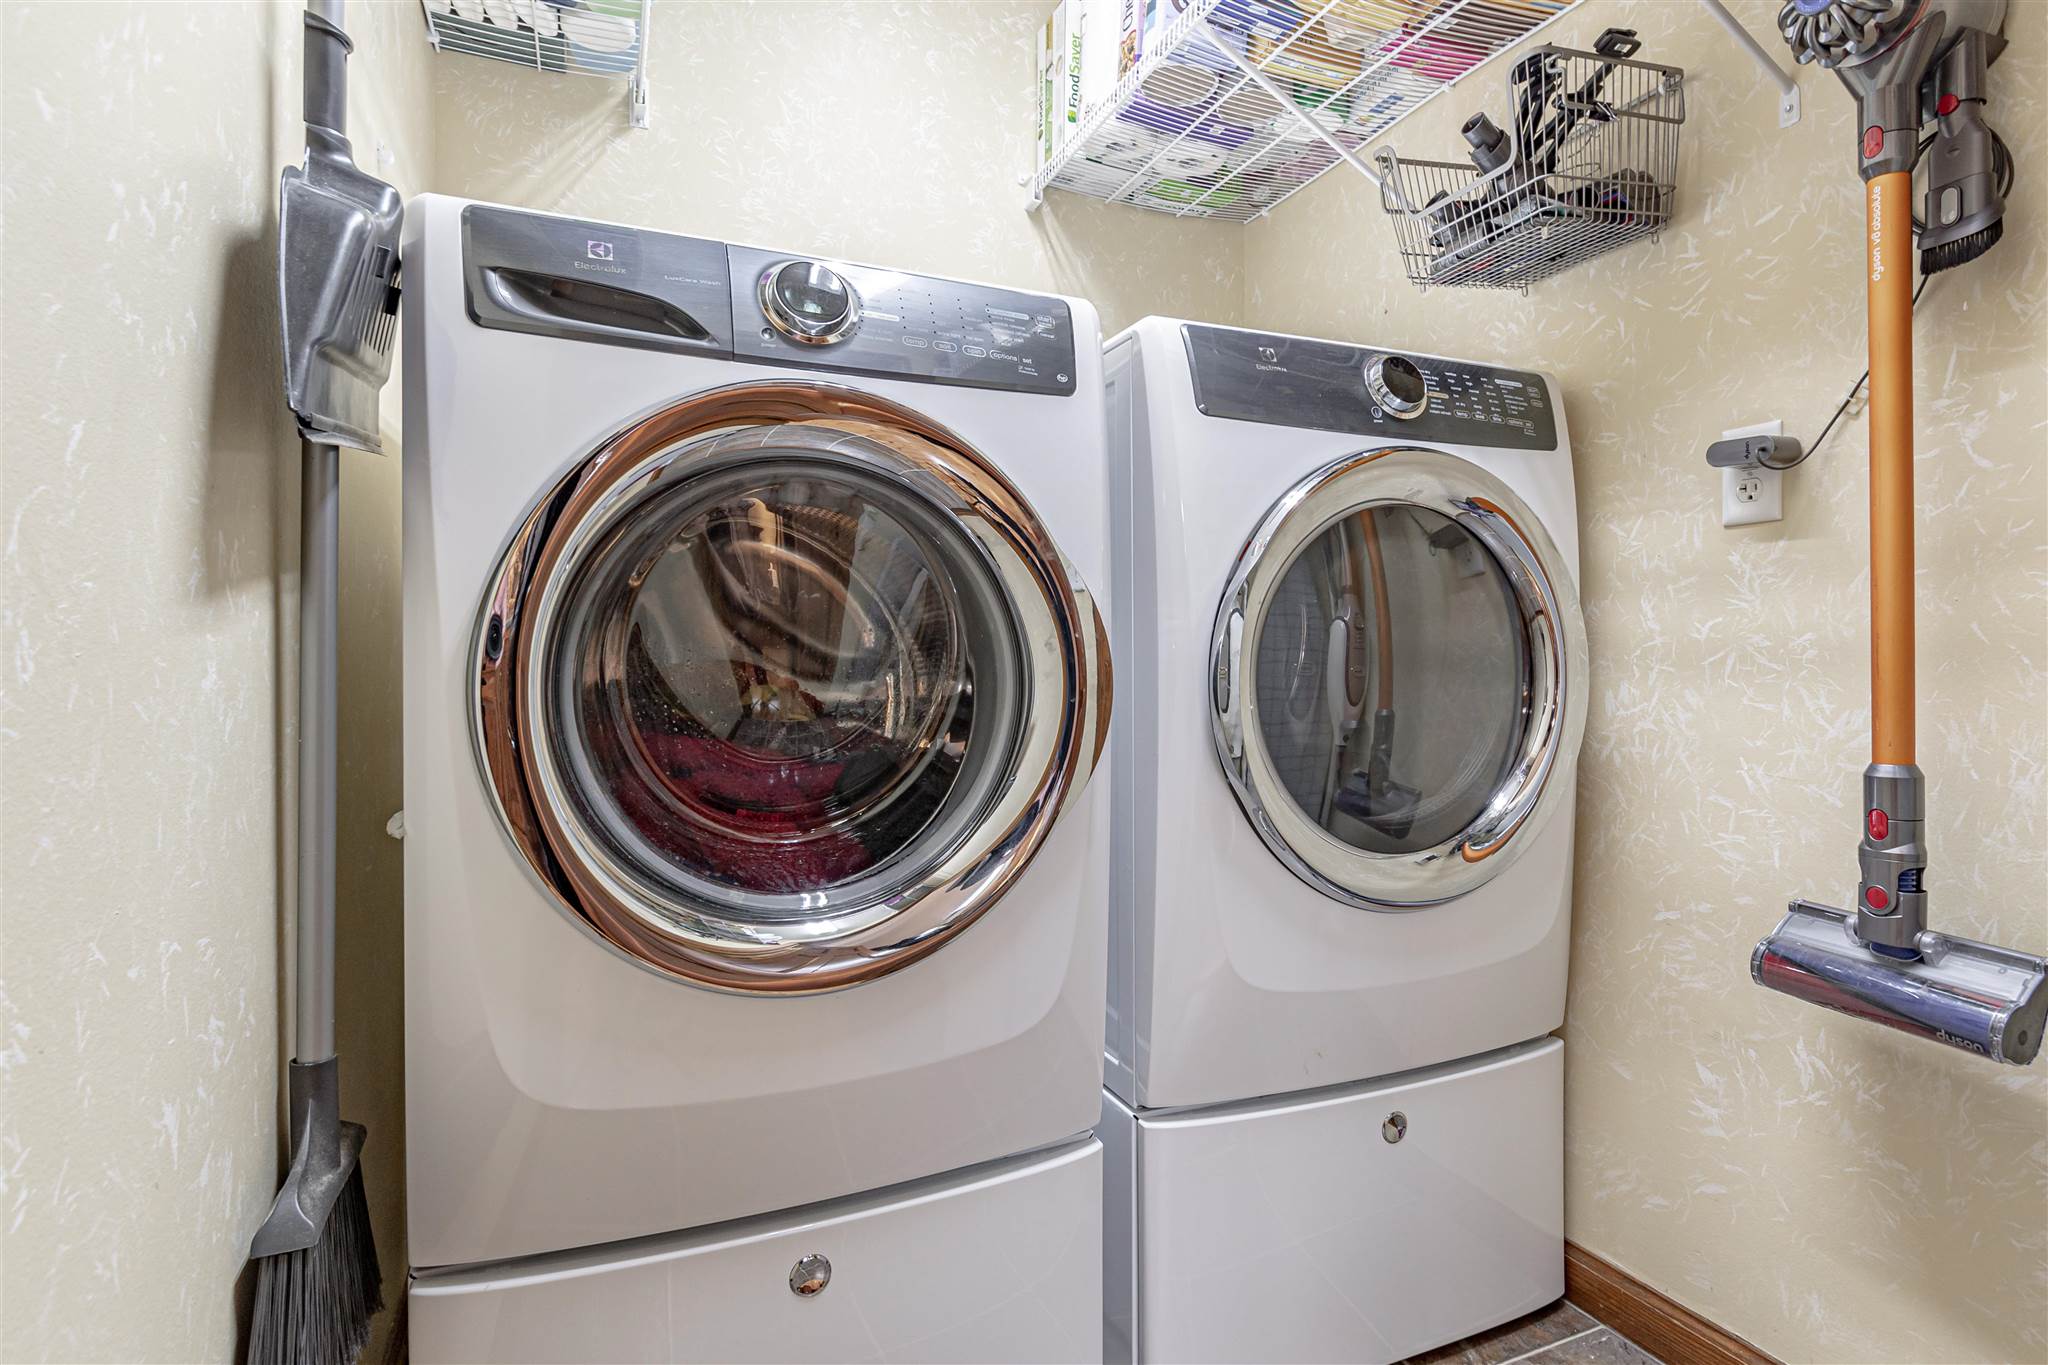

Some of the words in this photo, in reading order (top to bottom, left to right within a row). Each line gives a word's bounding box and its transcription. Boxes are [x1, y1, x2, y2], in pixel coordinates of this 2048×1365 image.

[1068, 32, 1082, 108] FoodSaver
[1871, 185, 1881, 231] absolute
[574, 261, 627, 274] Electrolux
[1871, 247, 1885, 281] dyson
[992, 352, 1018, 362] options
